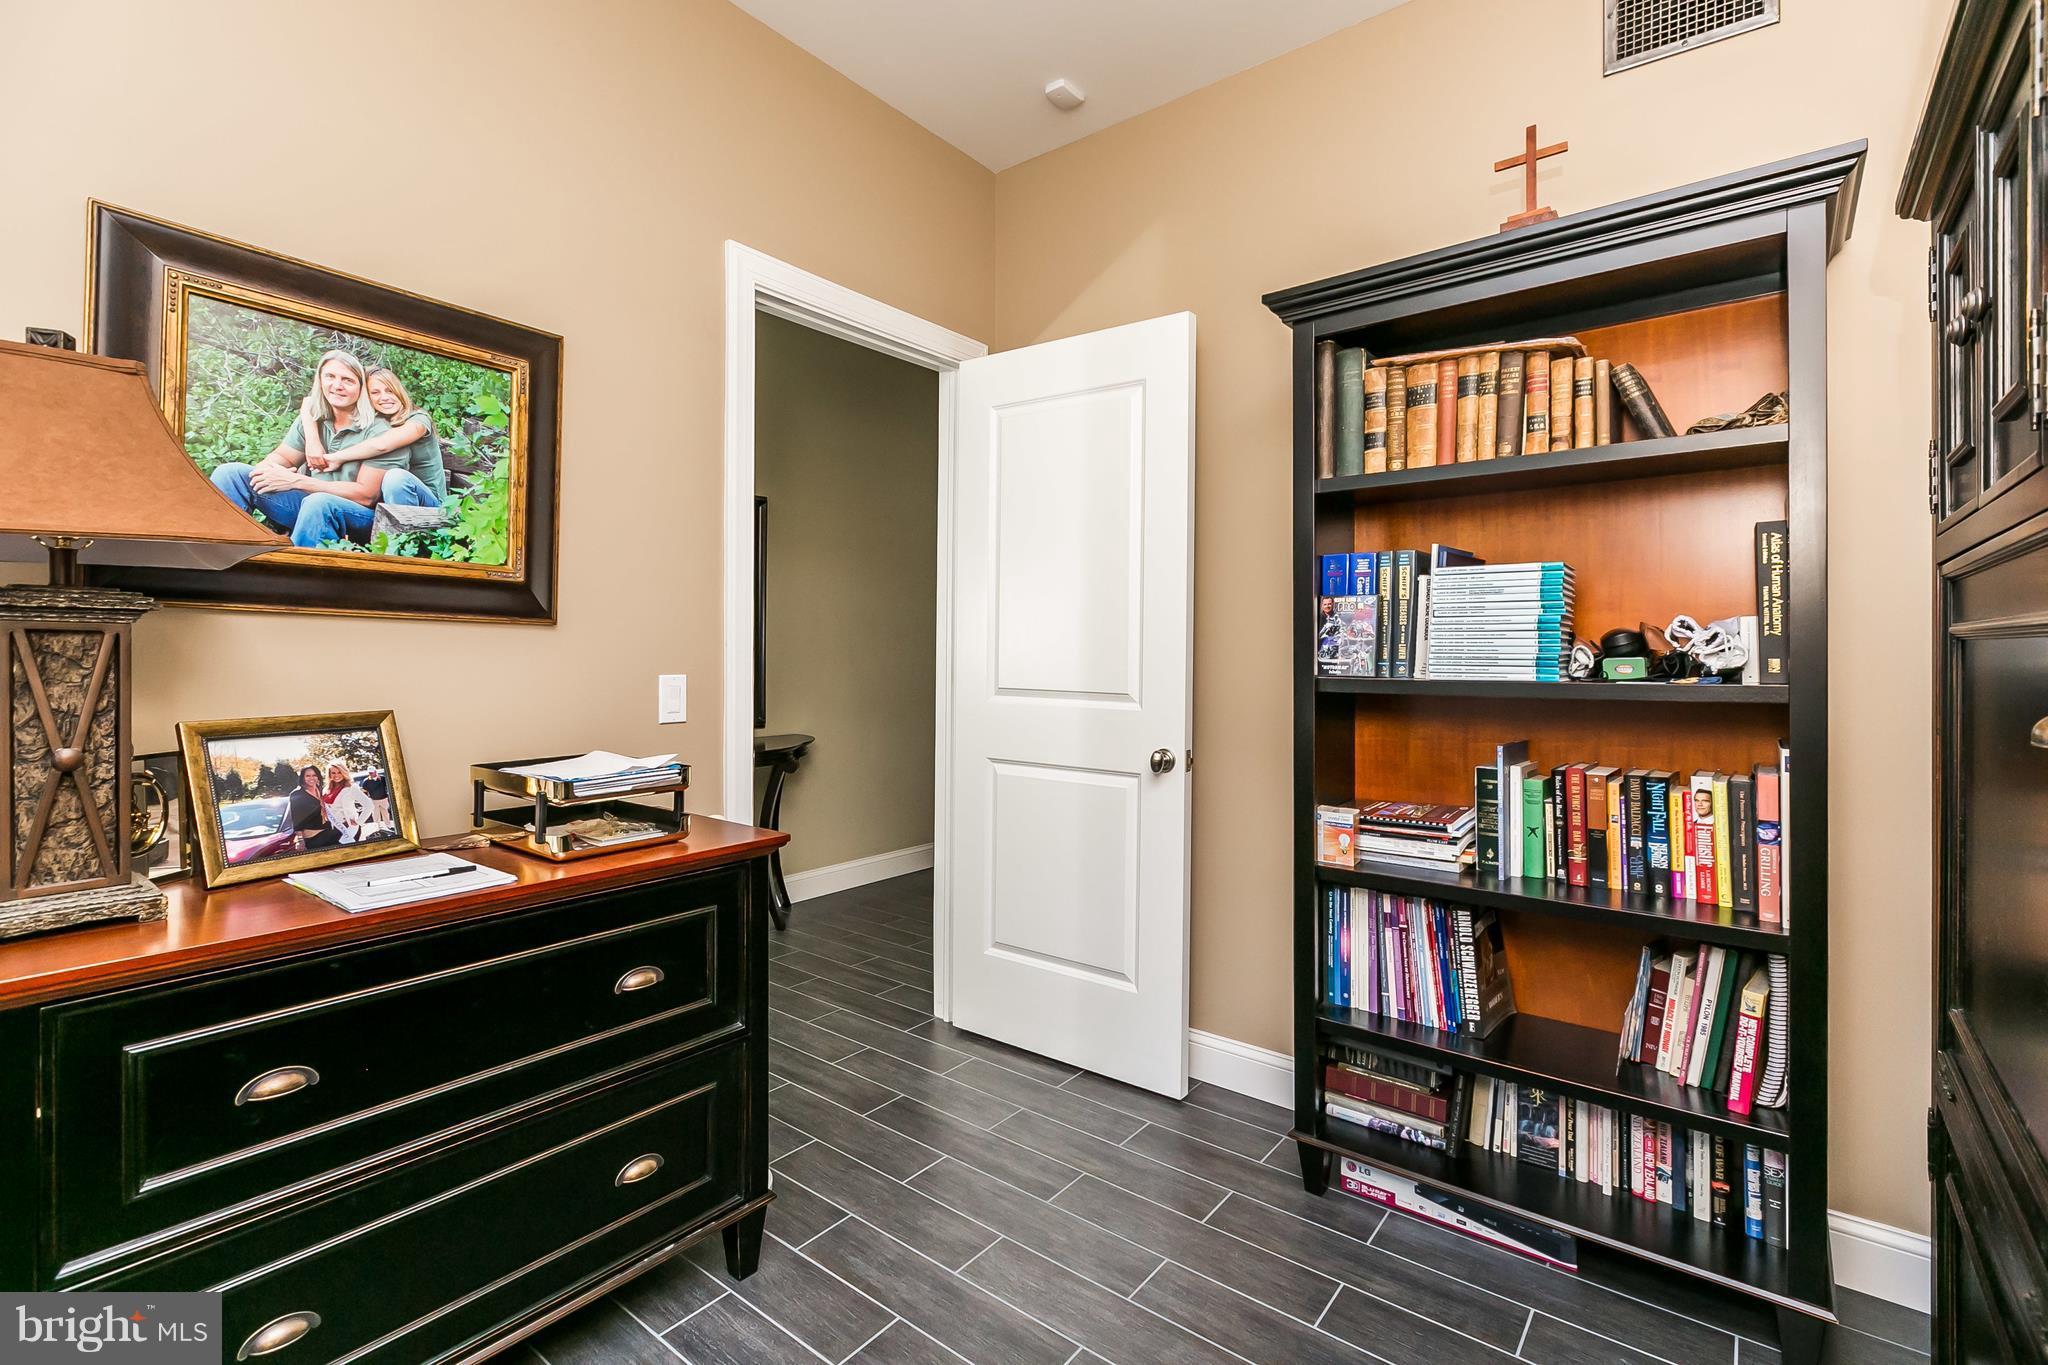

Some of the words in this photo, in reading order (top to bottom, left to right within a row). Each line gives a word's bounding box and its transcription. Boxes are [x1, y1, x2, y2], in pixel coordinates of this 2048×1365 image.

[1771, 533, 1783, 554] Atlas
[1771, 555, 1784, 564] of
[1772, 565, 1784, 599] Human
[1338, 603, 1356, 613] PRO
[1770, 599, 1784, 636] Anatomy
[1571, 774, 1580, 784] THE
[1571, 786, 1581, 794] DA
[1631, 779, 1641, 801] DAVID
[1572, 795, 1581, 810] VINCI
[1573, 812, 1582, 826] CODE
[1631, 802, 1642, 837] BALDACCI
[1573, 830, 1582, 842] DAN
[1659, 843, 1669, 869] NELSON
[1695, 826, 1715, 868] Fantastic
[1760, 848, 1771, 897] GRILLING
[1458, 910, 1473, 943] ARNOLD
[1461, 945, 1481, 1021] SCHWARZENEGGER
[1666, 998, 1676, 1021] MIRACLE
[1703, 999, 1713, 1020] PYLON
[1665, 1022, 1673, 1030] AT
[1700, 1023, 1708, 1036] 1985
[1747, 1019, 1758, 1037] NEW
[1734, 1016, 1749, 1072] DO-IT-YOURSELF
[1743, 1036, 1757, 1073] COMPLETE
[1730, 1072, 1742, 1101] MANUAL
[1633, 1116, 1642, 1133] NEW
[1633, 1134, 1642, 1174] ZEALAND
[1645, 1152, 1656, 1169] NEW
[1715, 1144, 1724, 1157] OF
[1359, 1166, 1371, 1176] LG
[1715, 1158, 1724, 1180] WAR
[1764, 1167, 1785, 1178] SEX
[1645, 1168, 1656, 1200] ZEALAND
